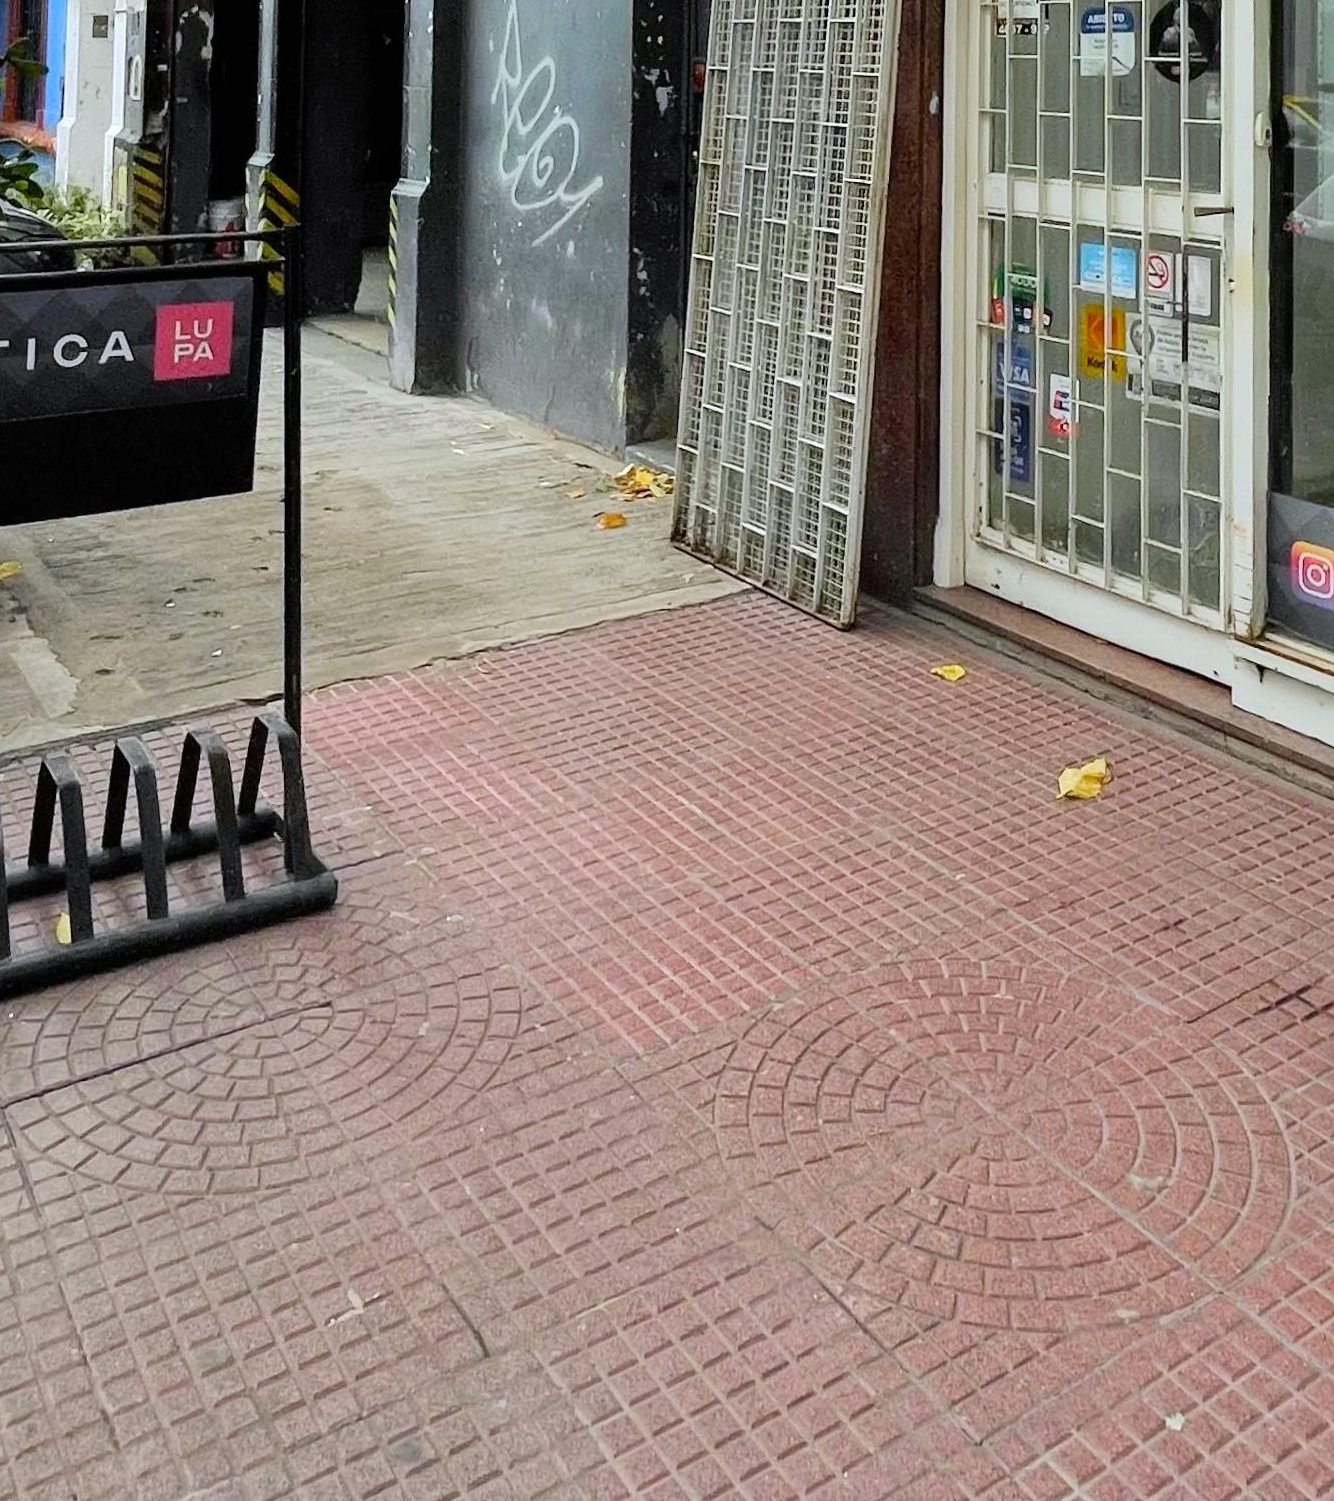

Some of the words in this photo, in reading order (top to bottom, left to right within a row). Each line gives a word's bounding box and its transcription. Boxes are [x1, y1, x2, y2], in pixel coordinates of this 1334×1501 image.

[175, 319, 213, 340] LU
[174, 341, 213, 363] PA
[999, 362, 1030, 384] VSA
[1087, 356, 1118, 373] Kodk
